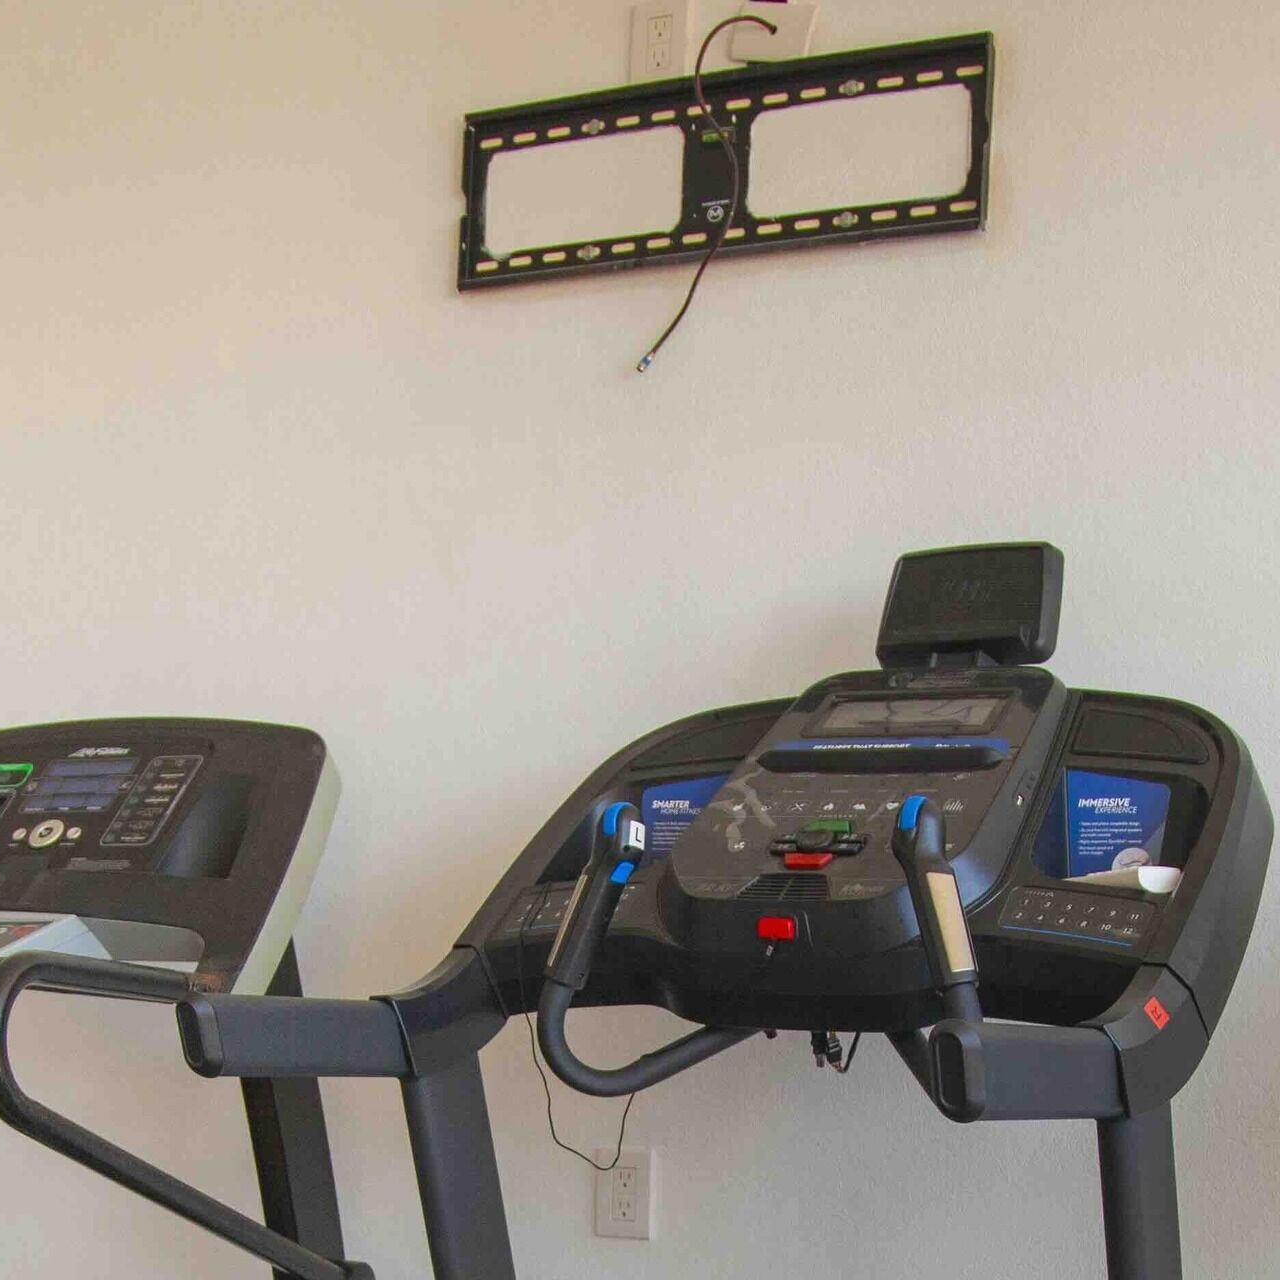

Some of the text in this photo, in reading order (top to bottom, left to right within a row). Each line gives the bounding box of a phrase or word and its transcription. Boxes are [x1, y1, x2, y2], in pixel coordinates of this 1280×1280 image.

[652, 800, 690, 809] SMARTER
[1078, 797, 1131, 808] IMMERSIVE
[1095, 806, 1138, 814] EXPERIENCE
[636, 827, 643, 843] L
[1101, 923, 1112, 931] 10
